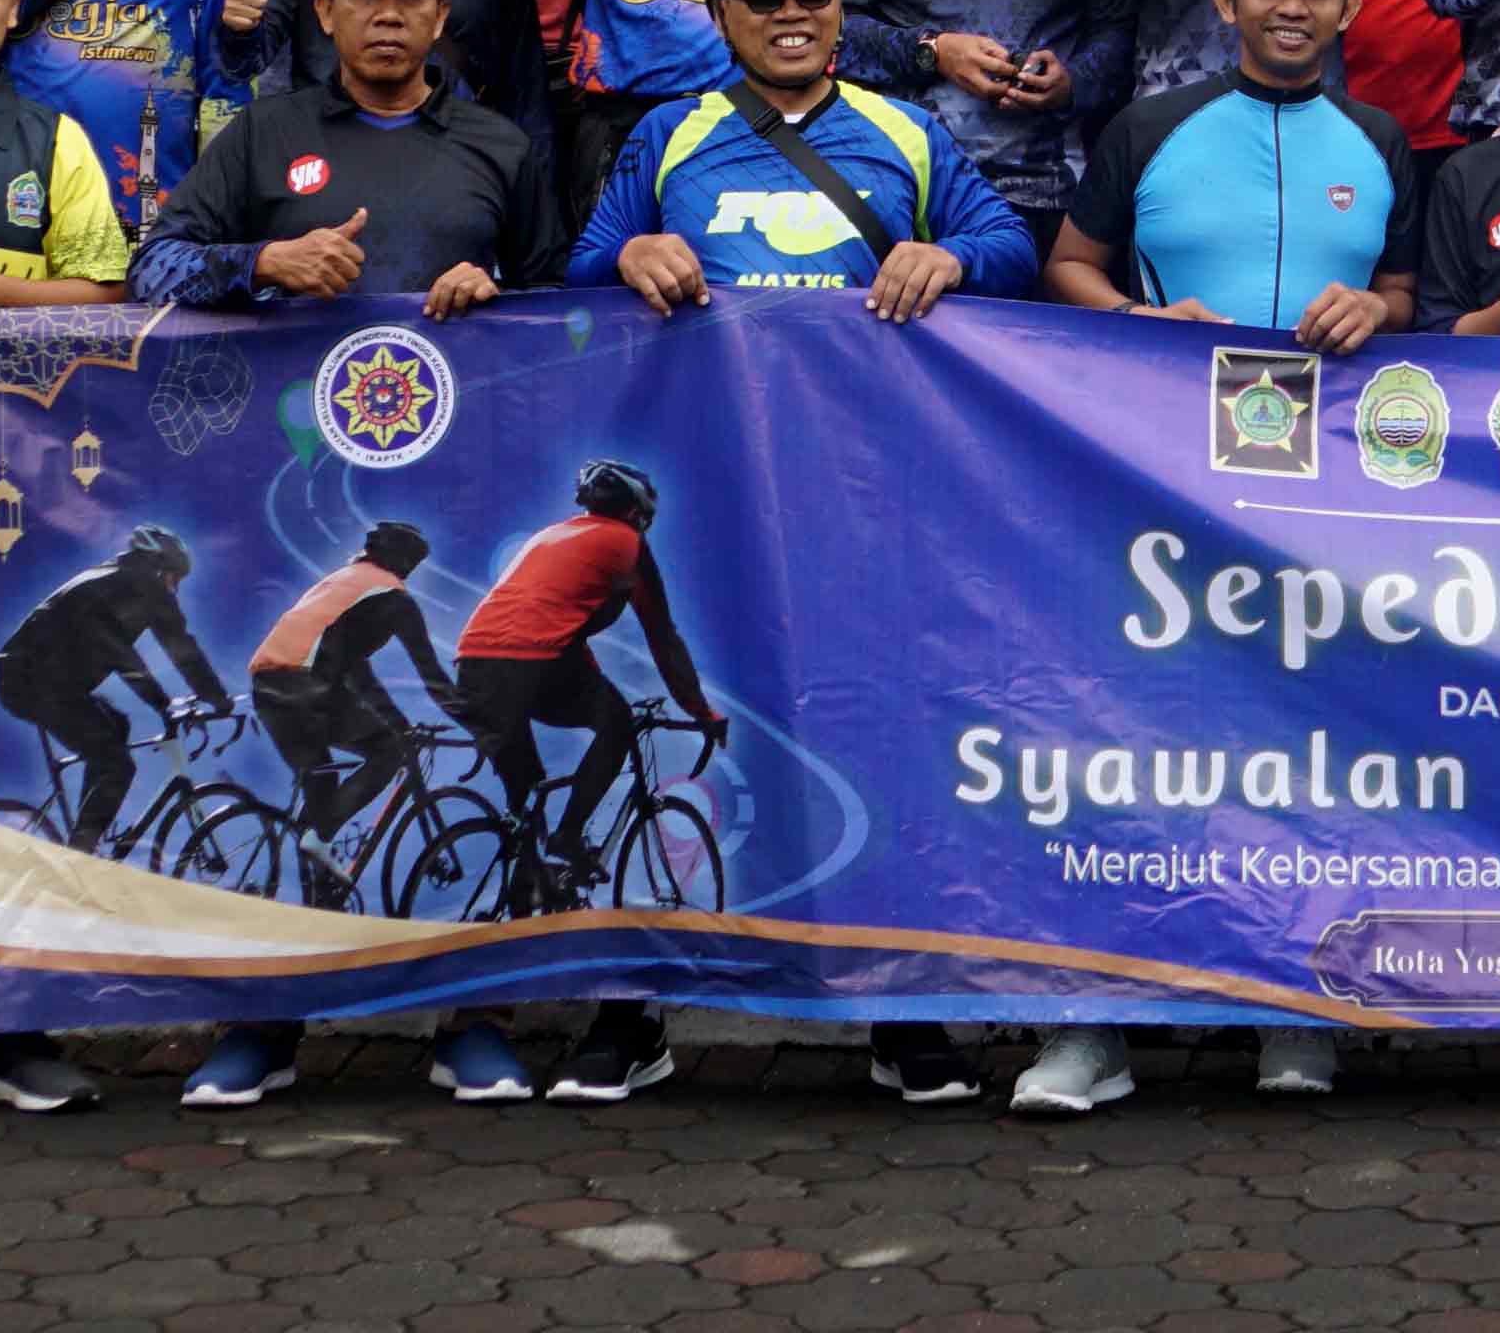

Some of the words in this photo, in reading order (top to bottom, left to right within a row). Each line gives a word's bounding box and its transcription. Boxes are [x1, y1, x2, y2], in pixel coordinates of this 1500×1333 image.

[291, 159, 322, 192] YK
[736, 274, 845, 288] MAXXIS
[954, 727, 1466, 826] Syawalan
[1373, 947, 1444, 975] Kota
